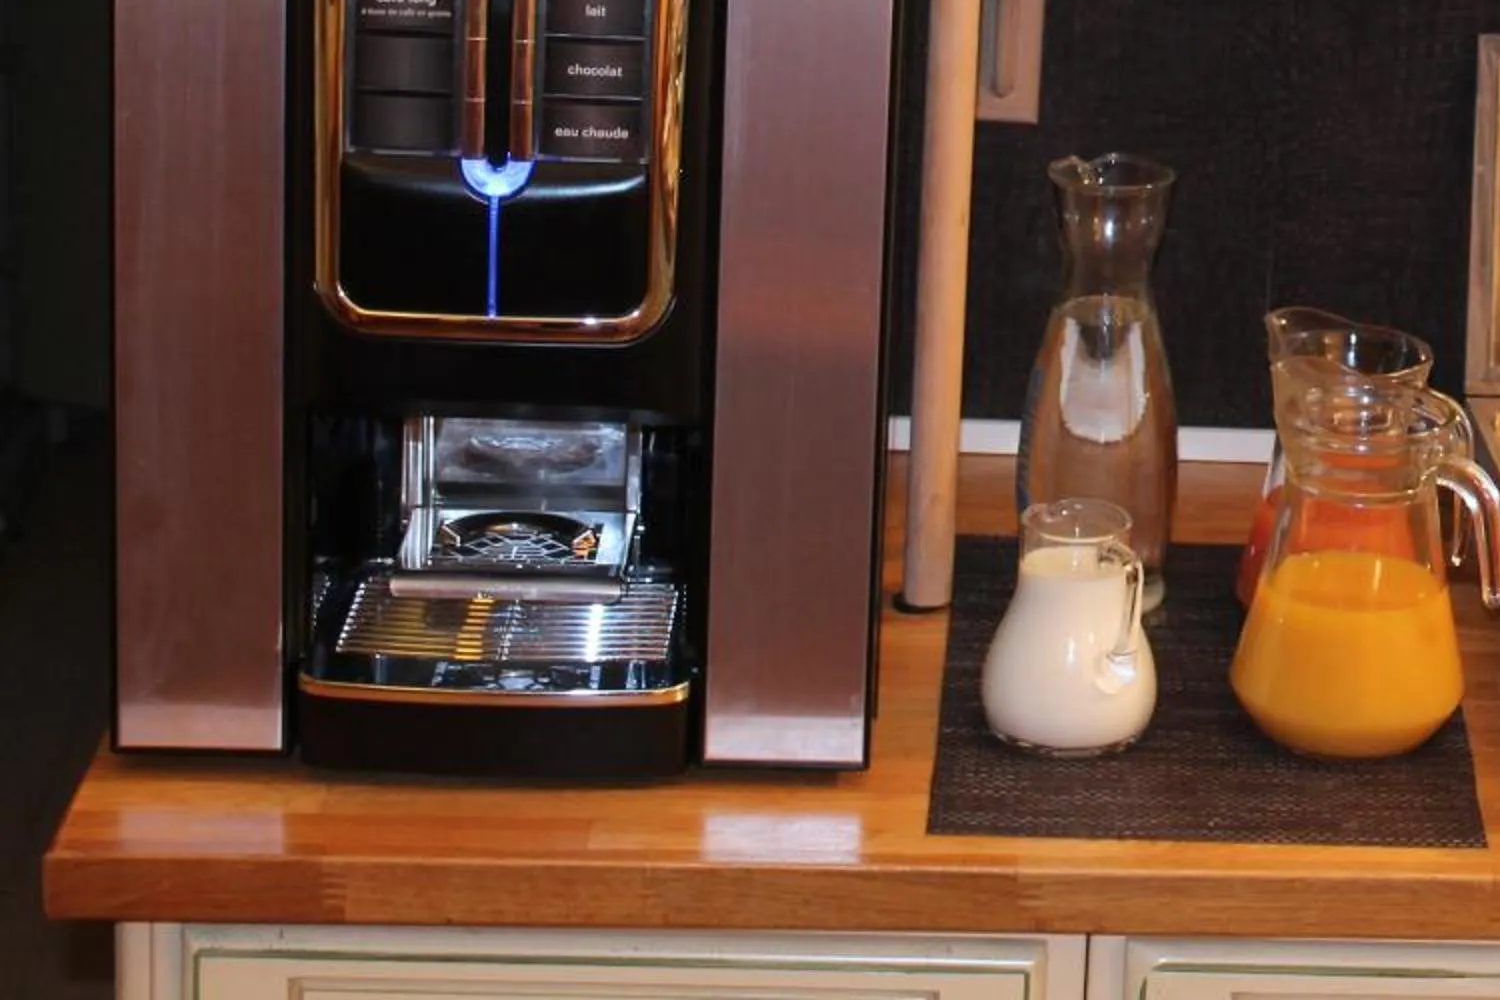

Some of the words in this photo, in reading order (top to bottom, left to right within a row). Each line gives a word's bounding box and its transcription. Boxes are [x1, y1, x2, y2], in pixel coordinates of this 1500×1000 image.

[585, 3, 607, 17] lait
[567, 63, 623, 77] chocolat
[555, 127, 579, 137] eau
[581, 125, 629, 139] chaude
